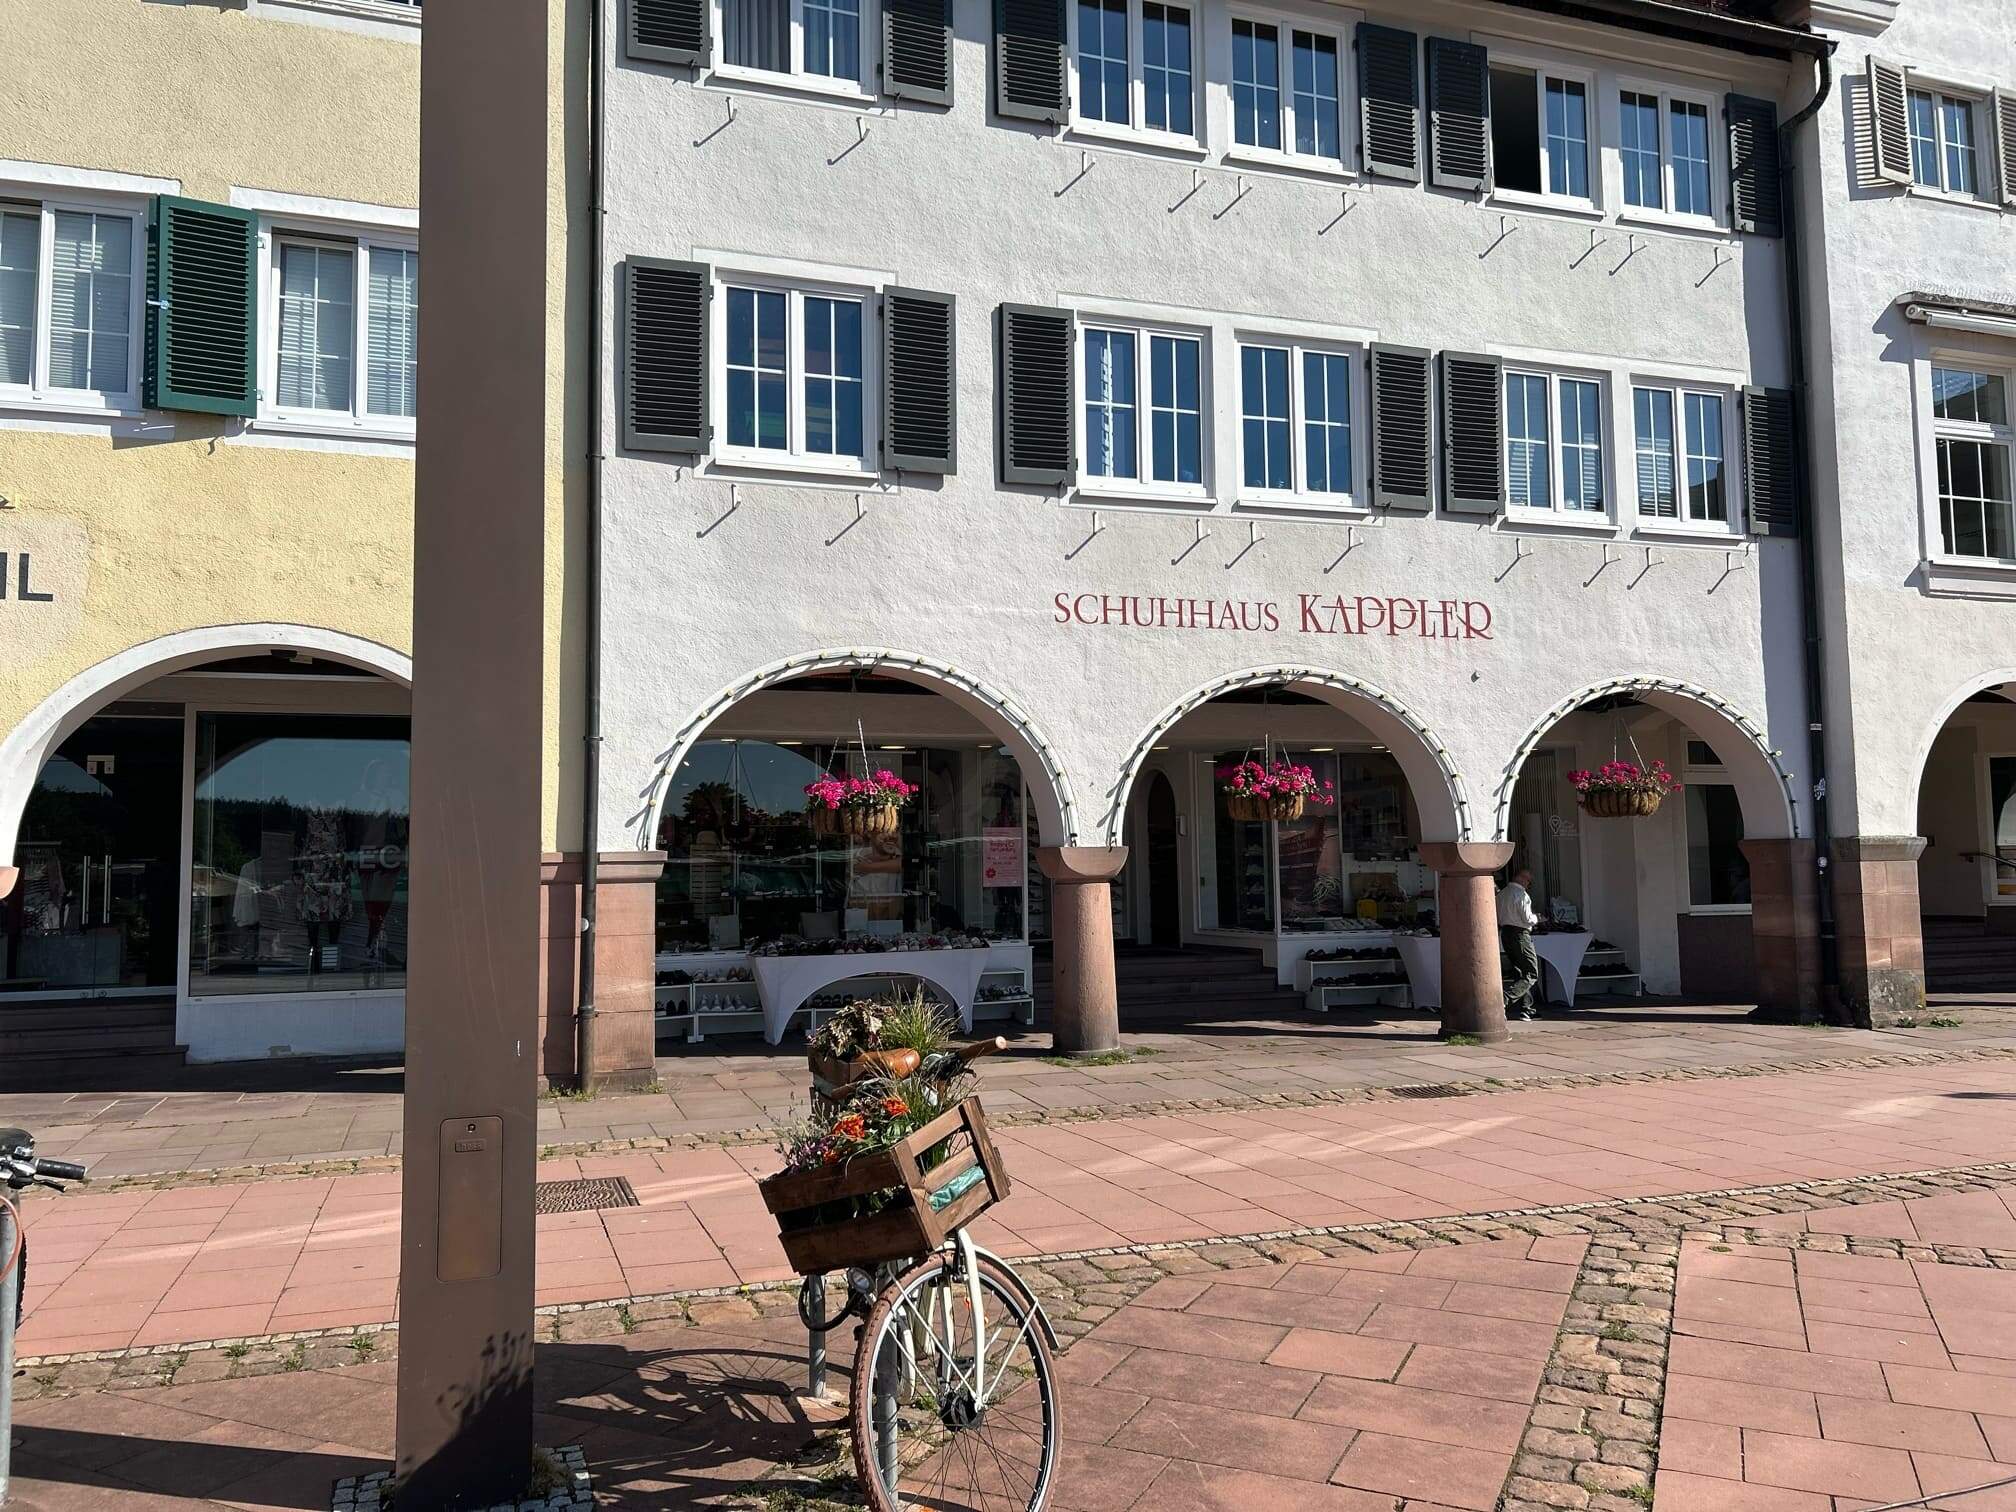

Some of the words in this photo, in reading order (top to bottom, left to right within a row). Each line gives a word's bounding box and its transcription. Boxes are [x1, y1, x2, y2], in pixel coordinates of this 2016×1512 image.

[1053, 592, 1280, 632] SCHUHHAUS
[1298, 593, 1494, 641] KAPPLER
[359, 844, 408, 869] EC
